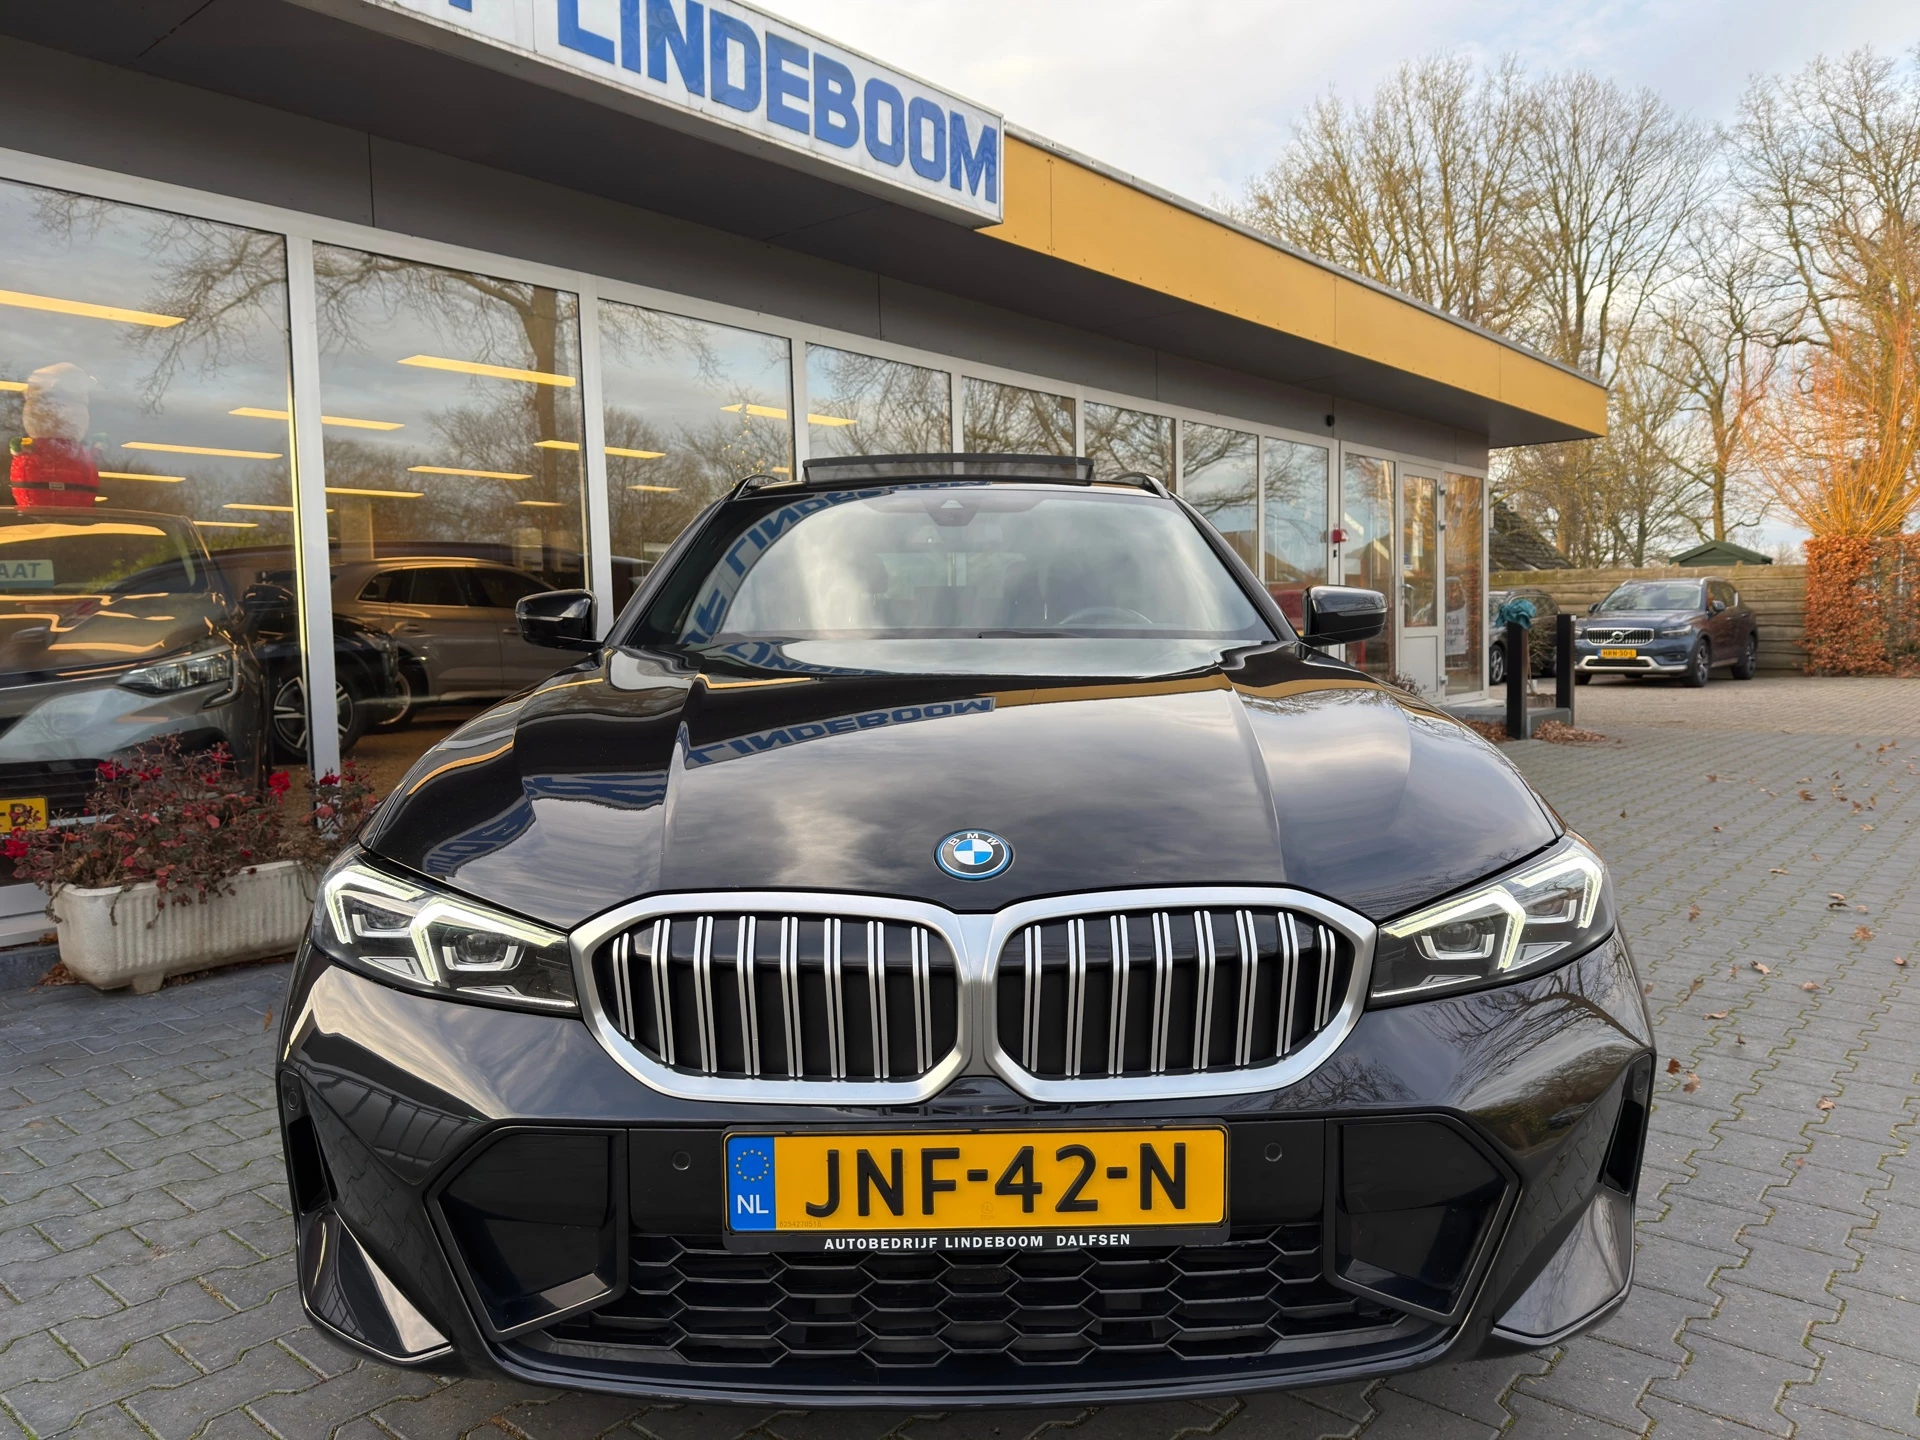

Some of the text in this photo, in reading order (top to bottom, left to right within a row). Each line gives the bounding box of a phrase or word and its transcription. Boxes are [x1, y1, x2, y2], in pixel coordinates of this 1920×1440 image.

[948, 833, 1000, 846] BMW
[805, 1142, 1187, 1218] JNF-42-N
[737, 1194, 769, 1214] NL
[824, 1234, 1130, 1250] AUTOBEDRIJF LINDEBOOM DALFSEN
